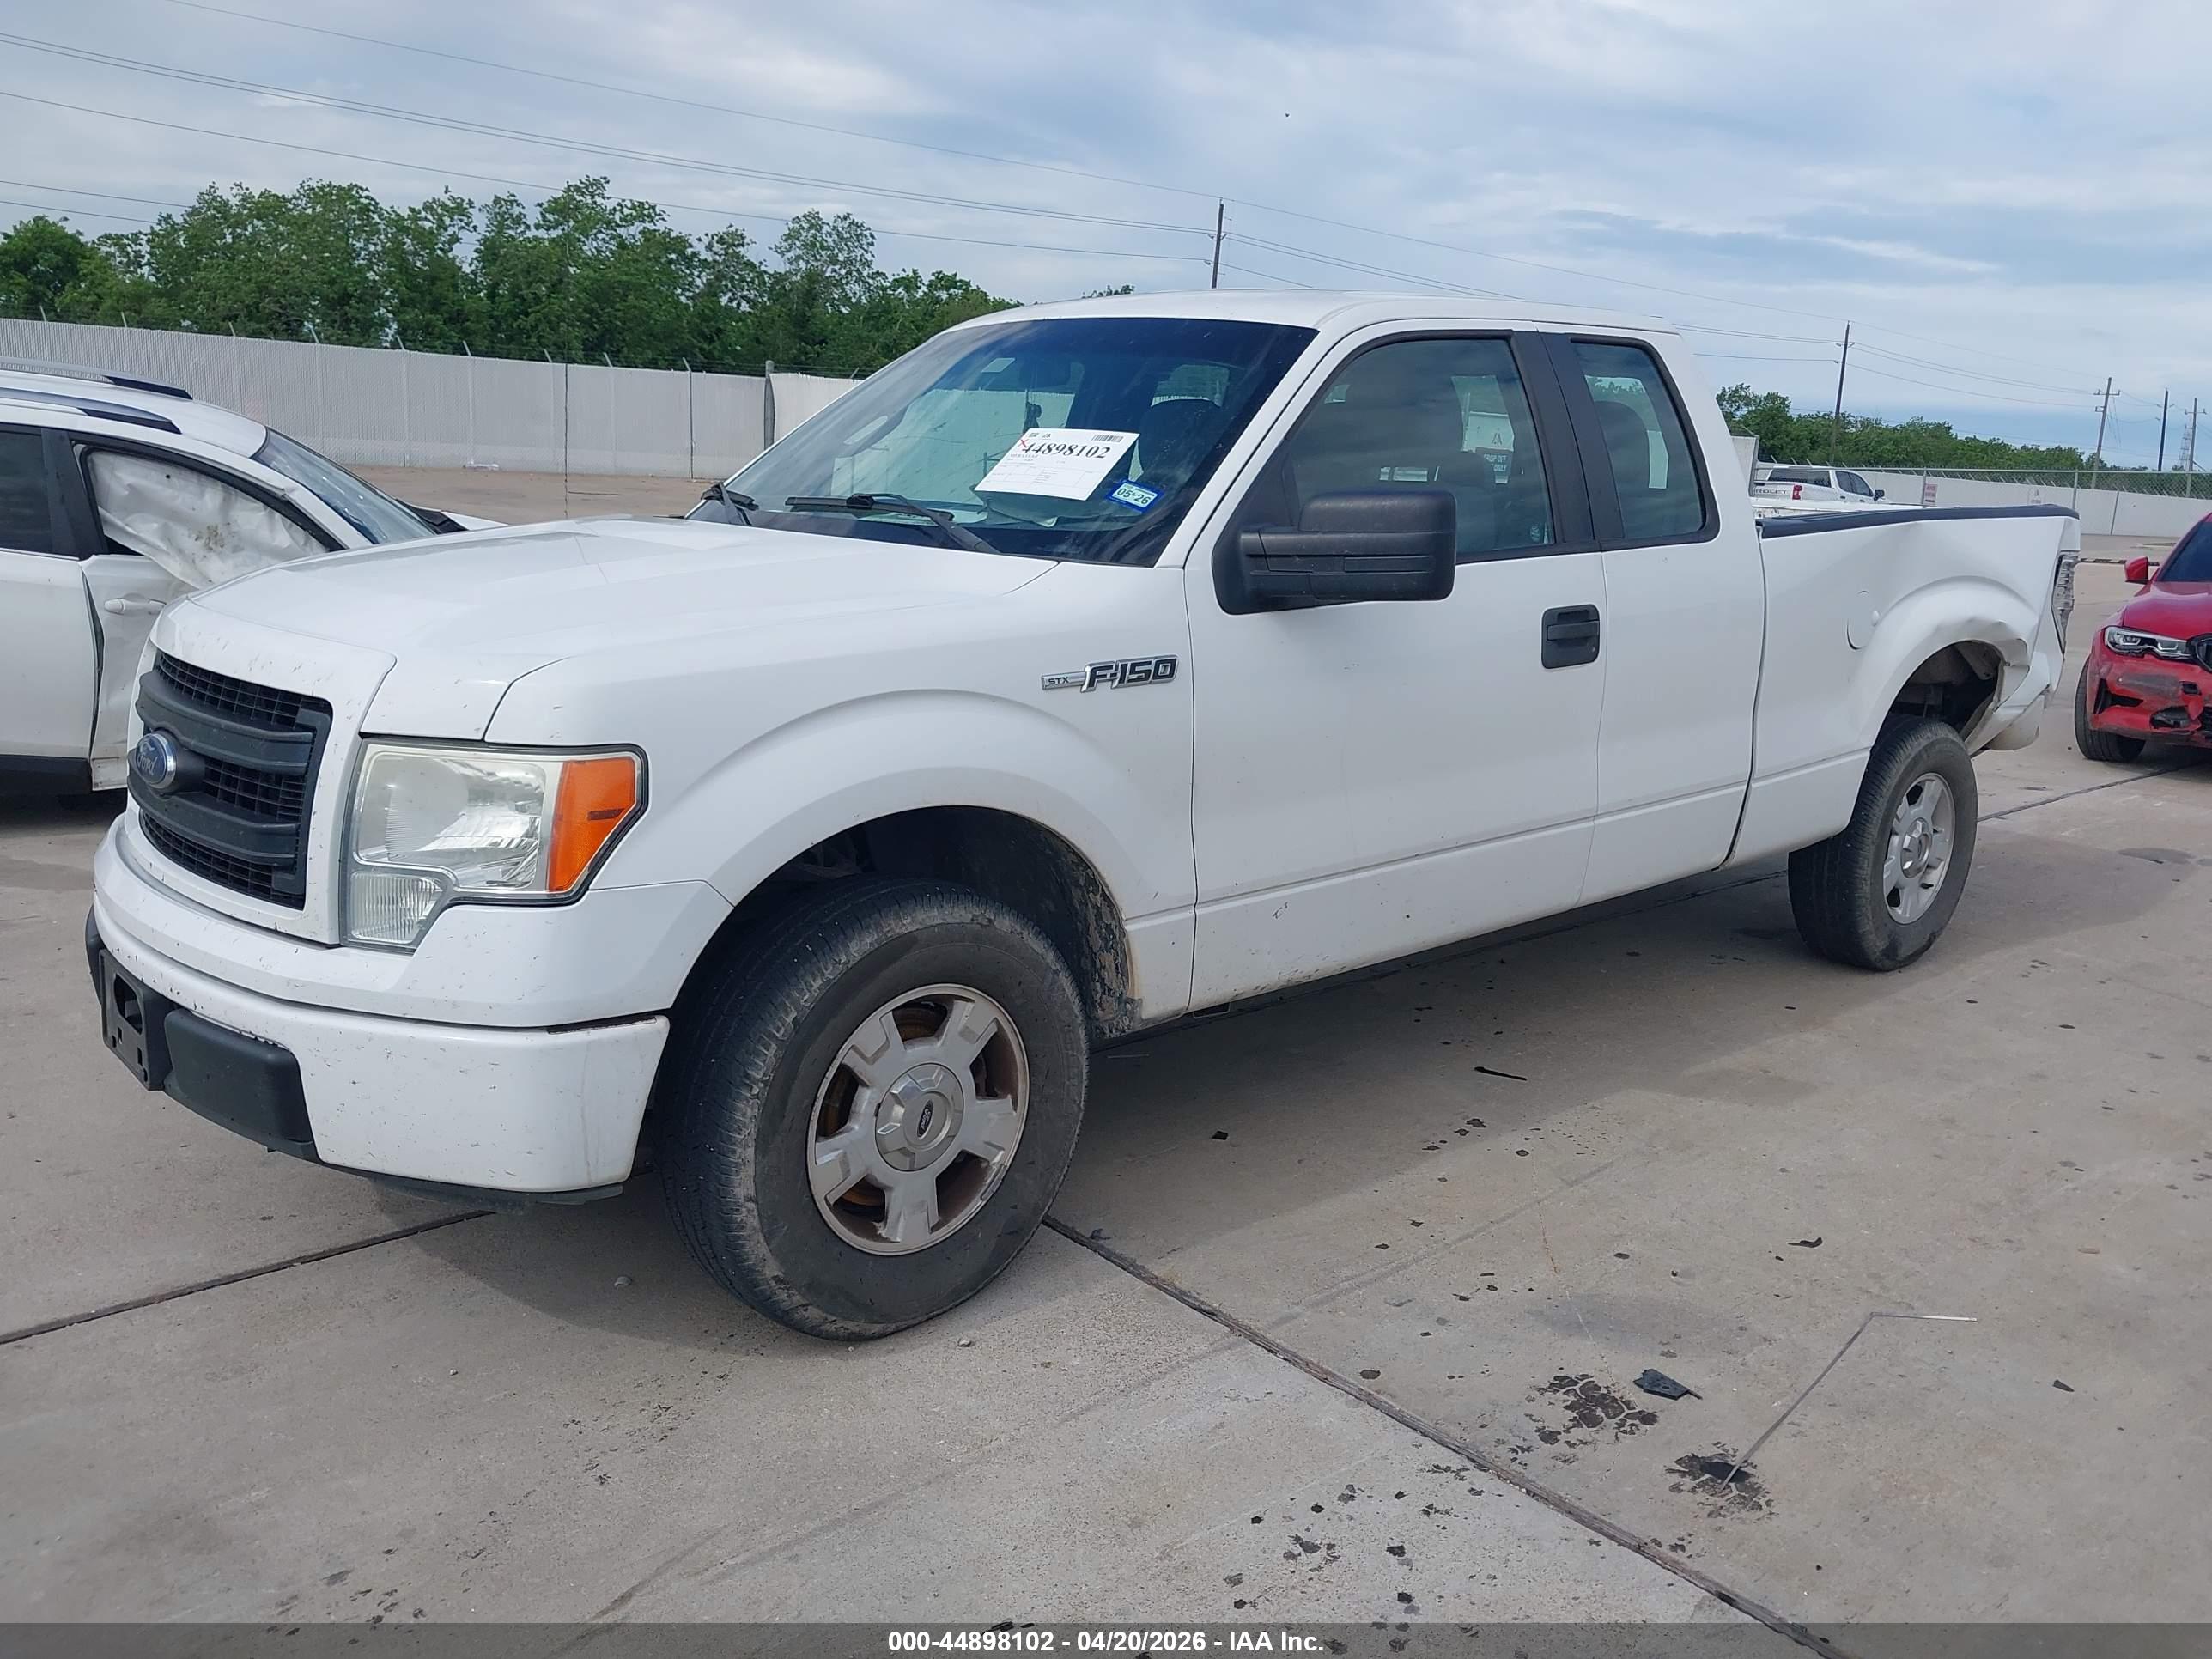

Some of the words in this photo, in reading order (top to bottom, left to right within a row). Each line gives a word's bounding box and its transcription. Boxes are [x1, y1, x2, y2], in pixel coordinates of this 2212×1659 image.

[1022, 442, 1111, 459] 44898102
[1048, 677, 1070, 685] STX
[1082, 655, 1179, 692] F-150
[137, 742, 158, 775] Ford
